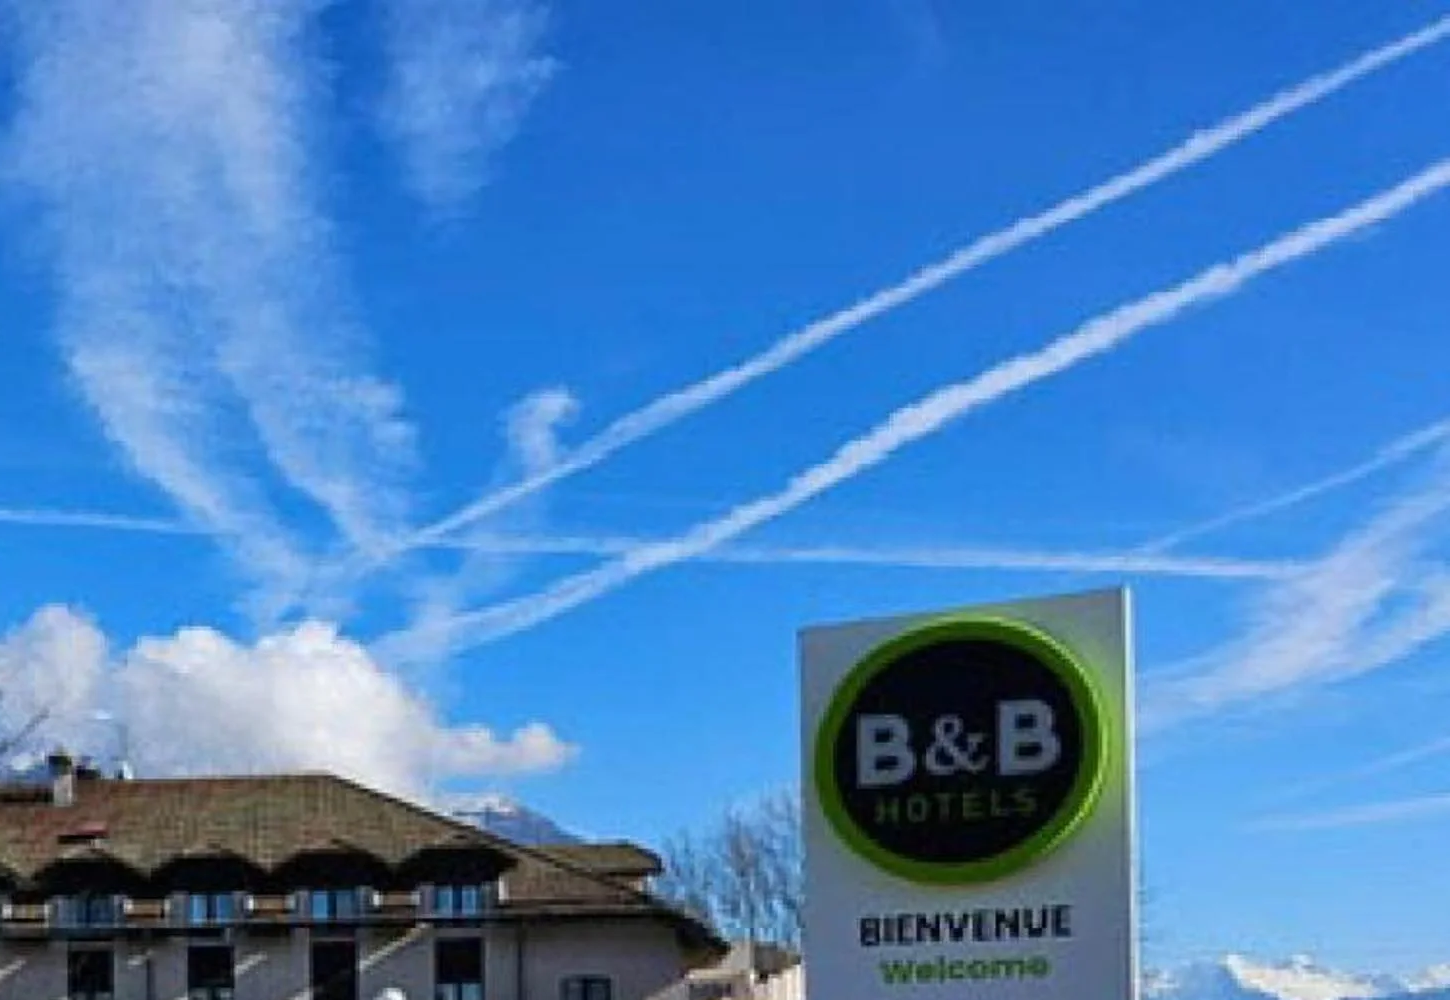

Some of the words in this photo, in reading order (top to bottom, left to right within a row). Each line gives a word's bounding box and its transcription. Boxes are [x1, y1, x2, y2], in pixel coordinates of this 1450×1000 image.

[856, 699, 1061, 789] B&B
[873, 788, 1038, 826] HOTELS
[859, 904, 1074, 947] BIENVENUE
[880, 953, 1050, 985] Welcome
